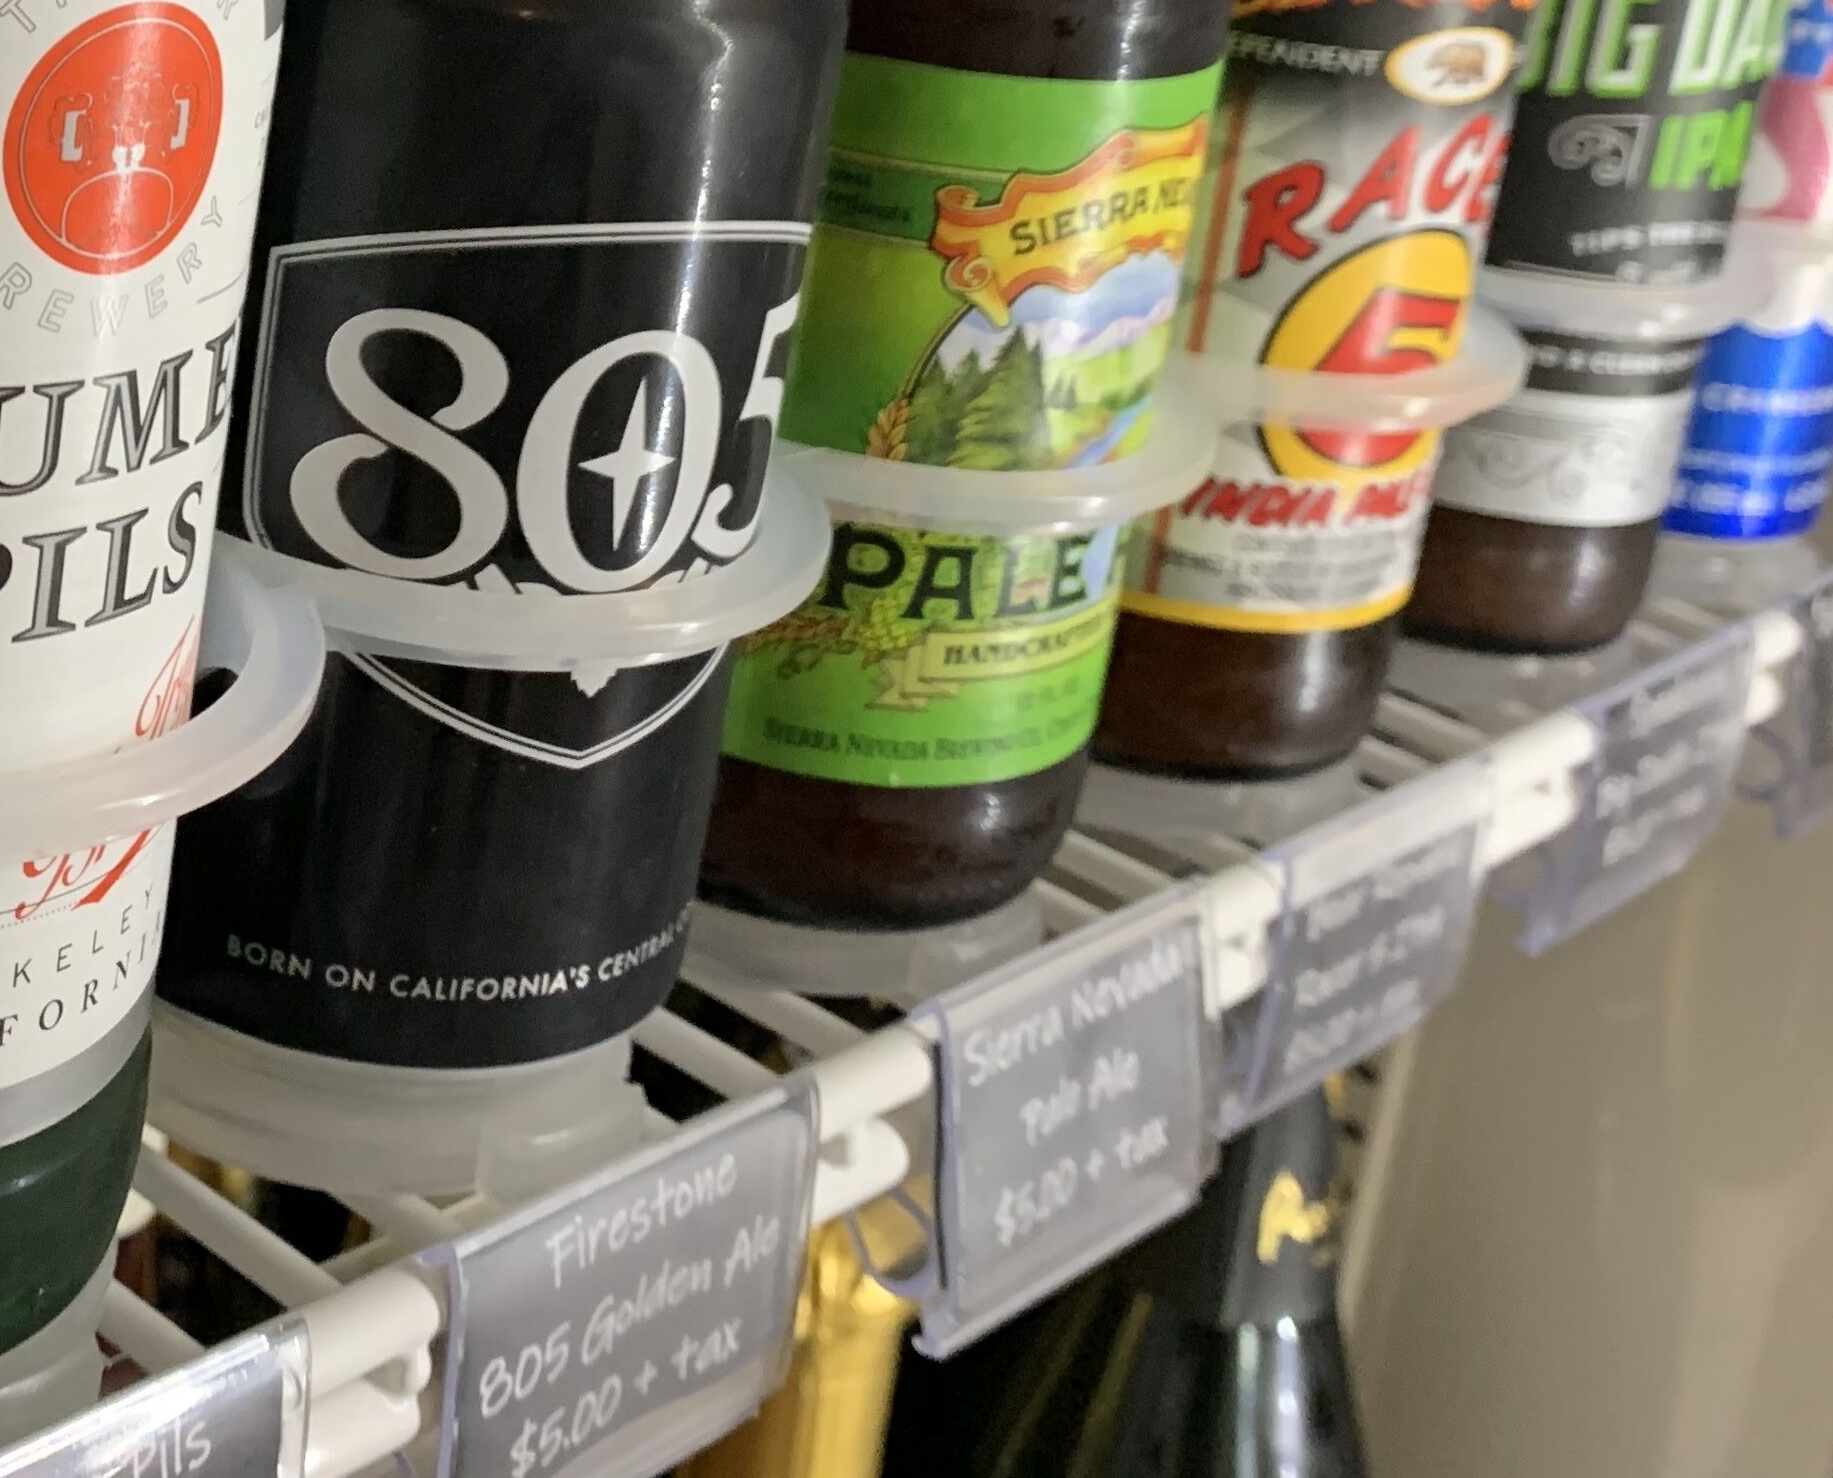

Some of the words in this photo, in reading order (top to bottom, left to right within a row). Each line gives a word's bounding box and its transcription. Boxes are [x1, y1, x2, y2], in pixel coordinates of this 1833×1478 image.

[1009, 187, 1148, 257] SIERRA
[288, 290, 802, 595] 805
[816, 519, 1094, 621] PALE
[226, 933, 312, 981] BORN
[324, 964, 376, 994] ON
[388, 966, 592, 1003] CALIFORNIA'S
[545, 1152, 739, 1290] Firestone
[479, 1319, 571, 1420] 805
[580, 1257, 714, 1366] Golden
[723, 1214, 781, 1289] Ale
[510, 1374, 623, 1478] $5.00
[672, 1315, 745, 1382] tax
